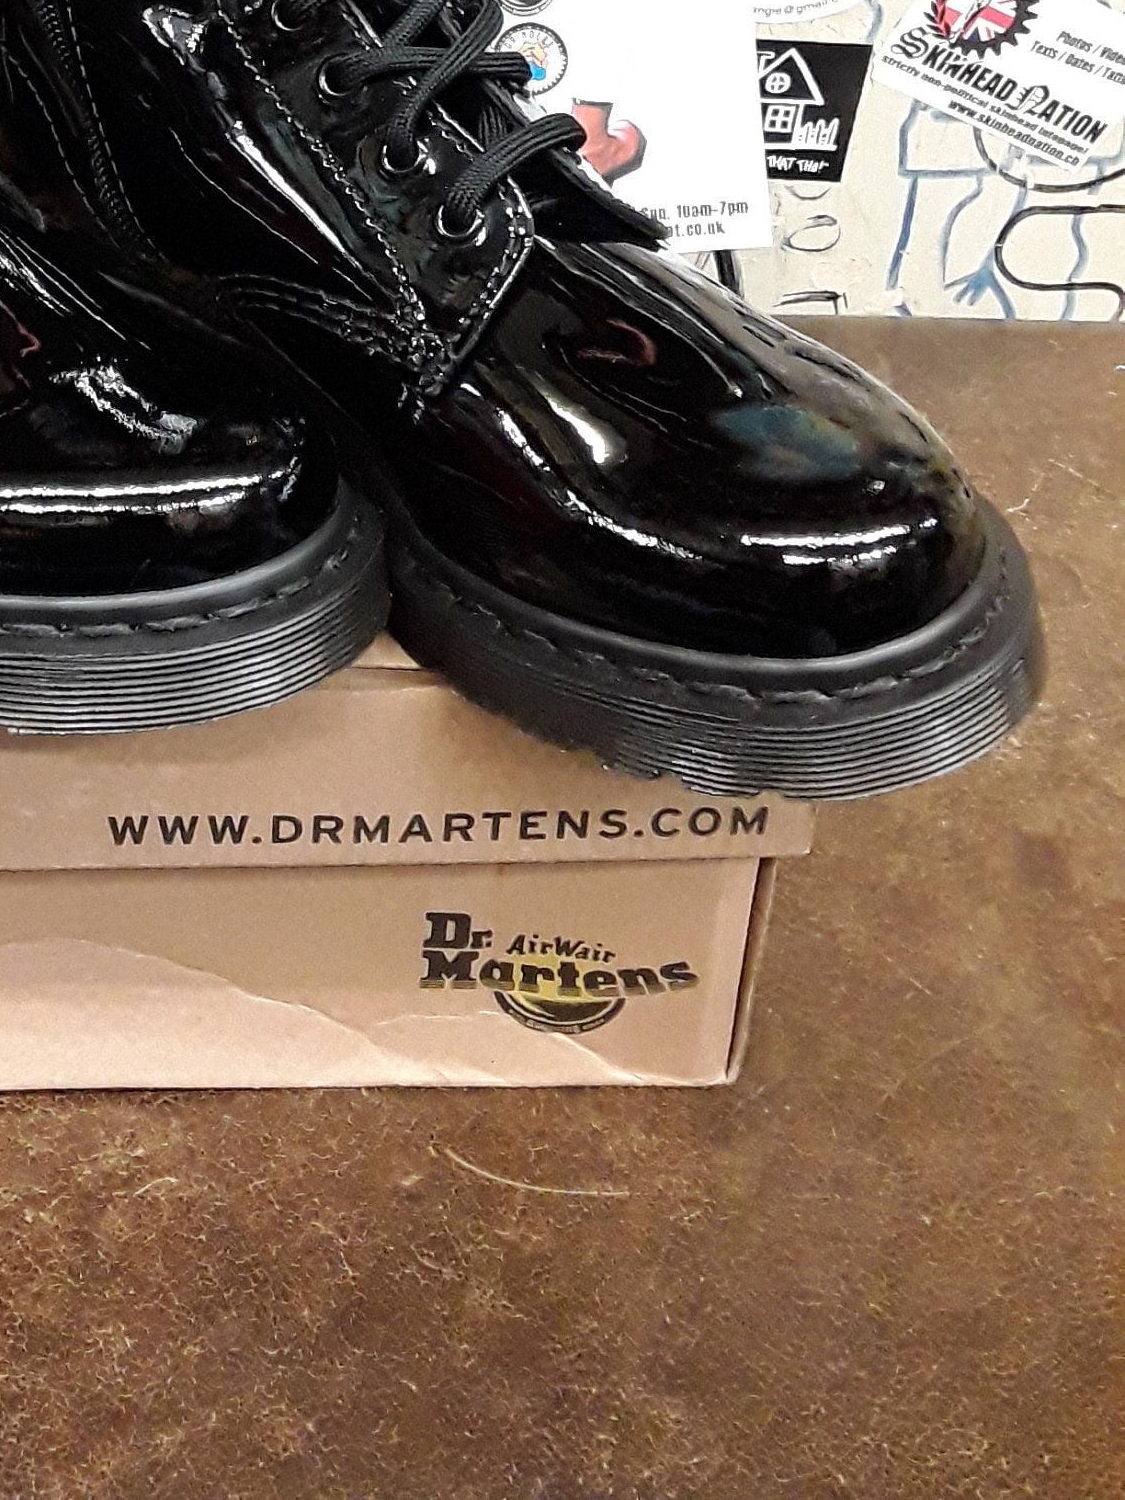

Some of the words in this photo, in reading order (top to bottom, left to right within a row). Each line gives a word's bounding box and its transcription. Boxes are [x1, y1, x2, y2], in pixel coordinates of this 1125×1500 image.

[890, 26, 1019, 101] SKINHEAD
[990, 104, 1039, 133] skinhead
[1005, 84, 1109, 145] NATION
[675, 200, 749, 219] 10am-7pm
[107, 805, 772, 847] WWW.DRMARTENS.COM
[423, 910, 493, 950] Dr.
[505, 932, 617, 965] AirWair
[418, 949, 701, 999] Martens
